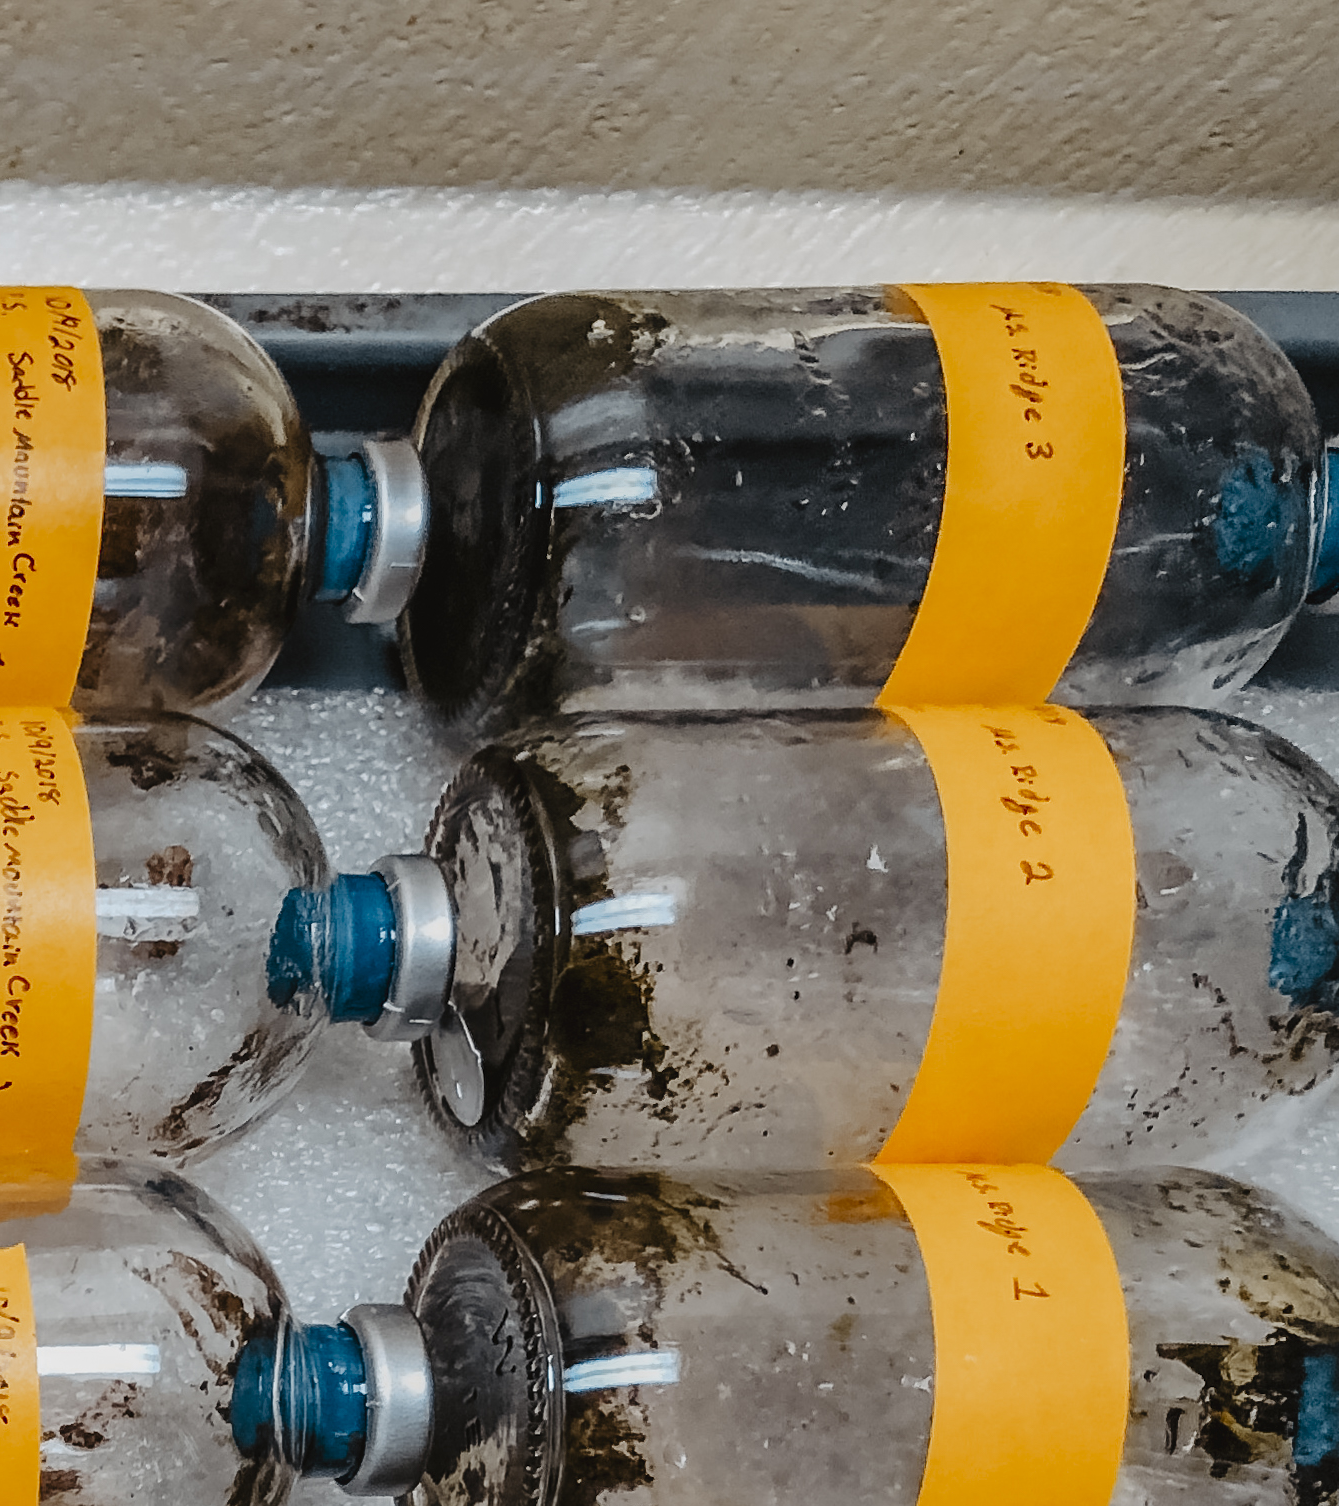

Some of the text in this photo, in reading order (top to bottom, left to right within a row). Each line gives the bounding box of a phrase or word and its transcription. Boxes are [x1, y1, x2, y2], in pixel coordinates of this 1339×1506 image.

[1010, 348, 1048, 422] Ridge
[1026, 441, 1054, 460] 3
[4, 553, 37, 628] Creek
[20, 720, 60, 806] 10/9/2018
[1000, 764, 1051, 837] Ridge
[1019, 861, 1054, 886] 2
[0, 974, 31, 1058] Creek
[976, 1201, 1031, 1257] Ridge
[1012, 1276, 1051, 1301] 1
